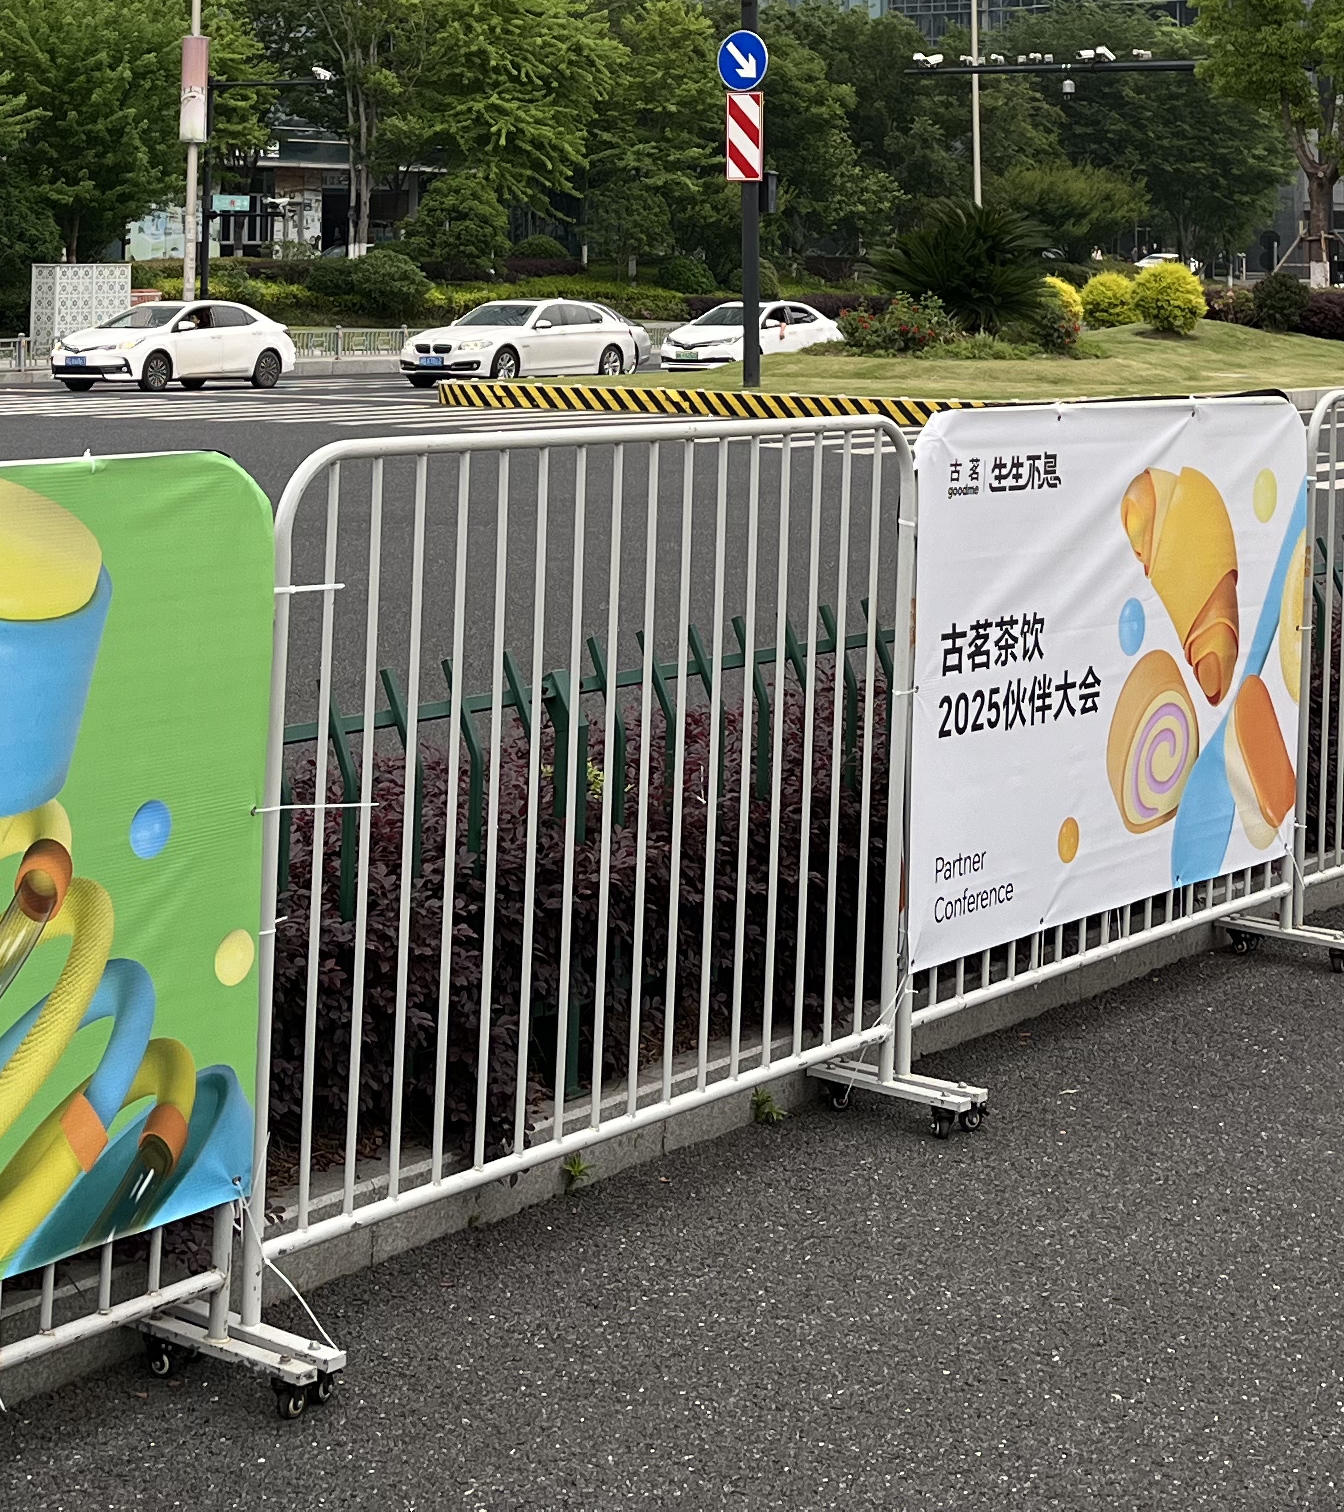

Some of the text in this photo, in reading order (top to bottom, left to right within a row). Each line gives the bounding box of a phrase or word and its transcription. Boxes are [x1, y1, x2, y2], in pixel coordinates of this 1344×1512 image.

[949, 451, 1062, 493] 古茗 生生不息
[940, 611, 1045, 677] 古茗茶饮
[938, 665, 1102, 739] 2025伙伴大会
[934, 850, 987, 884] Partner
[934, 882, 1014, 924] Conference
